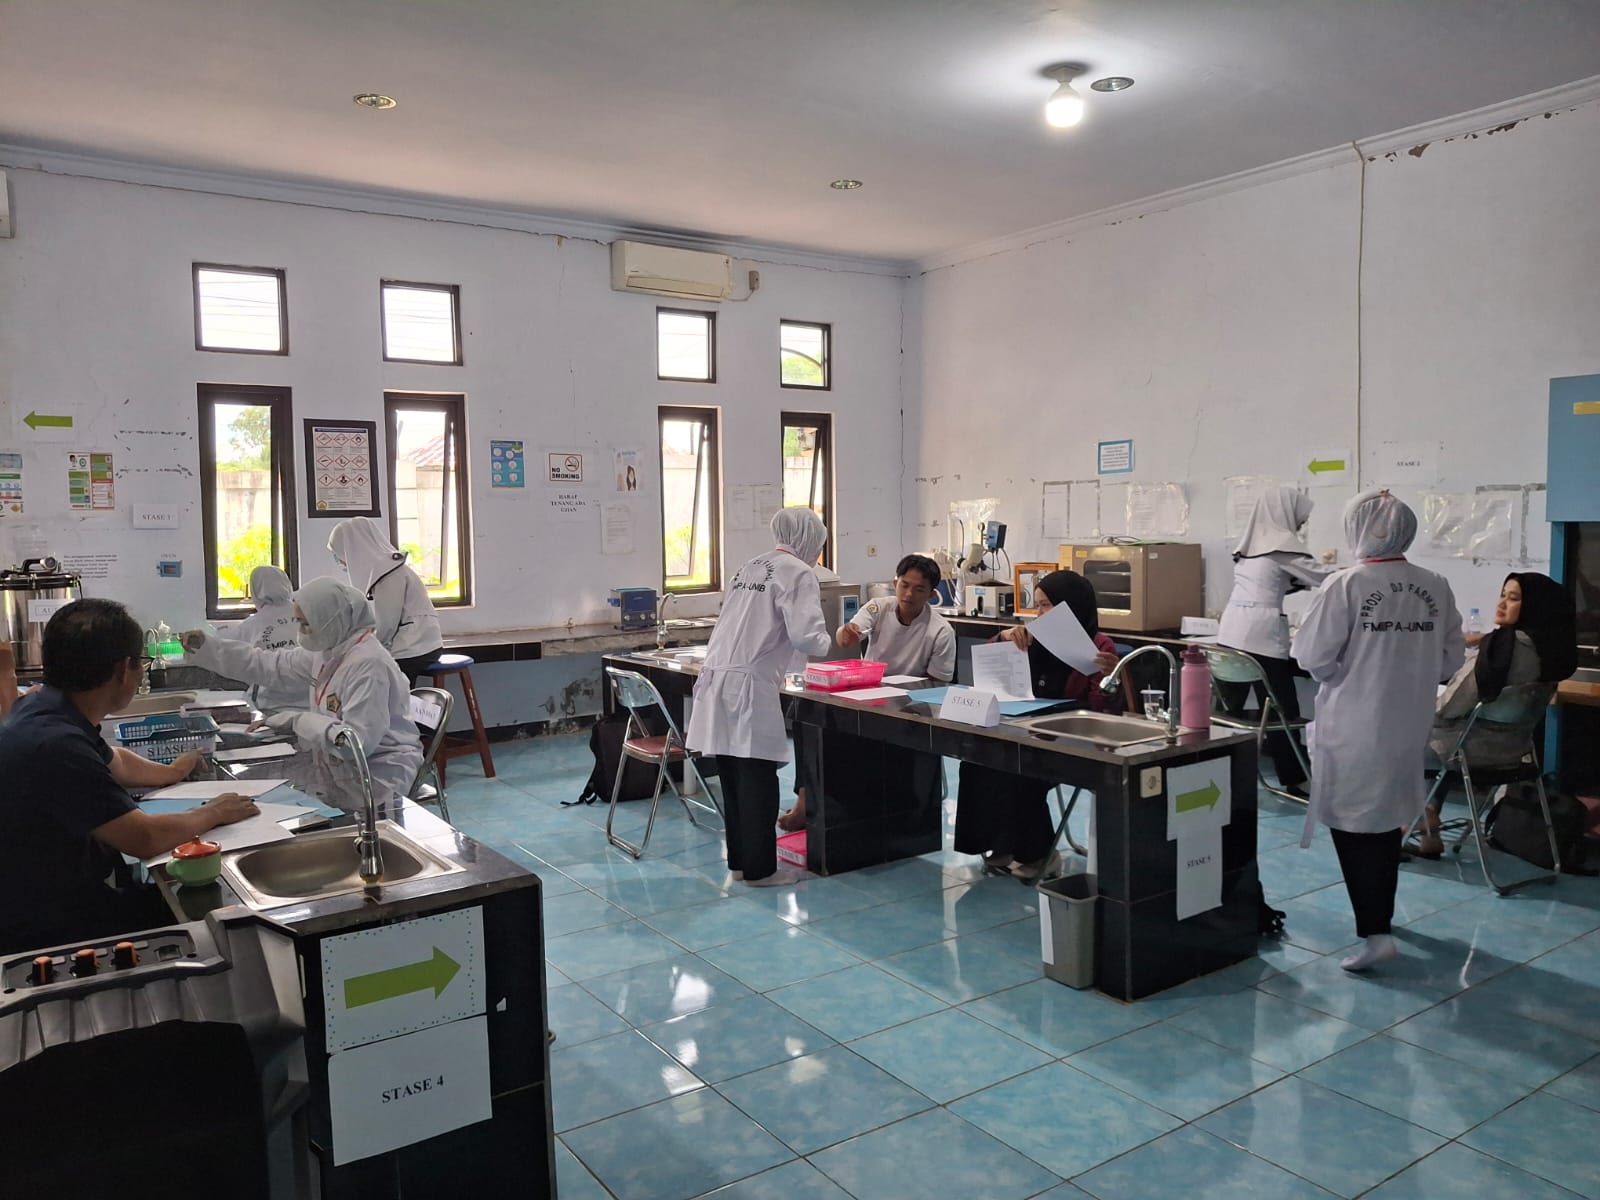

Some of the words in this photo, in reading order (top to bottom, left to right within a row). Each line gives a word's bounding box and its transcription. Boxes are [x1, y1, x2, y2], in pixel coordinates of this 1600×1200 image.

[1360, 590, 1385, 617] PRODI
[381, 1078, 433, 1104] STASE
[436, 1074, 444, 1086] 4
